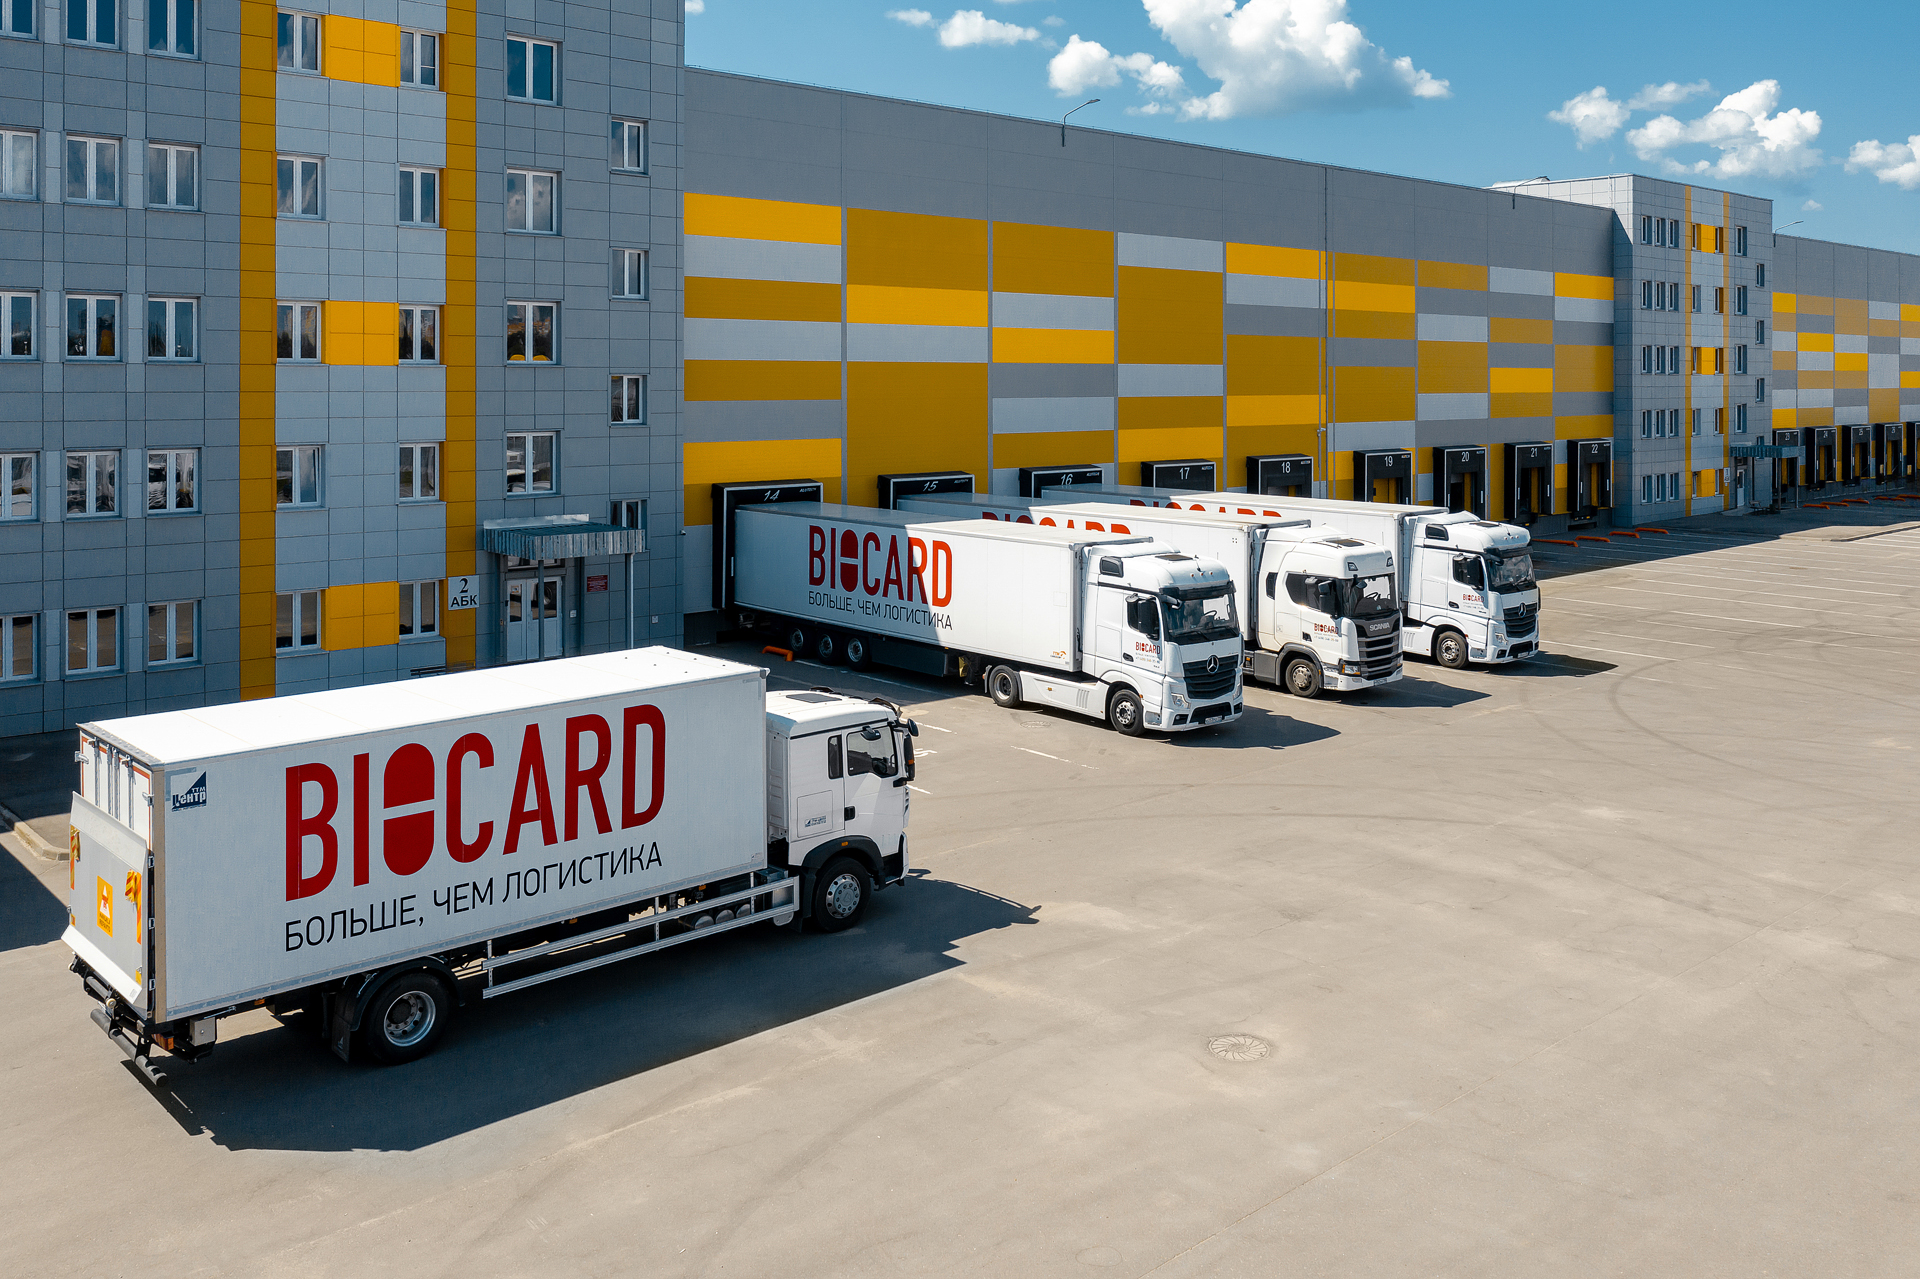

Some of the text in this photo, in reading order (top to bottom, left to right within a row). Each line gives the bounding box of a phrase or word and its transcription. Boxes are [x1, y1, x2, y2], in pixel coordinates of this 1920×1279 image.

[1530, 447, 1538, 458] 21
[1591, 443, 1599, 454] 22
[1384, 455, 1394, 467] 19
[1461, 451, 1470, 462] 20
[1179, 467, 1190, 480] 17
[1281, 461, 1291, 474] 18
[1060, 473, 1074, 485] 16
[923, 480, 939, 492] 15
[763, 489, 780, 502] 14
[809, 525, 953, 608] BIOCARD
[459, 577, 469, 594] 2
[450, 594, 478, 608] АБК
[808, 591, 953, 631] БОЛЬШЕ, ЧЕМ ЛОГИСТИКА
[1369, 622, 1391, 632] SCANIA
[1135, 641, 1161, 655] BIOCARD
[286, 703, 666, 902] BIOCARD
[285, 841, 663, 952] БОЛЬШЕ, ЧЕМ ЛОГИСТИКА
